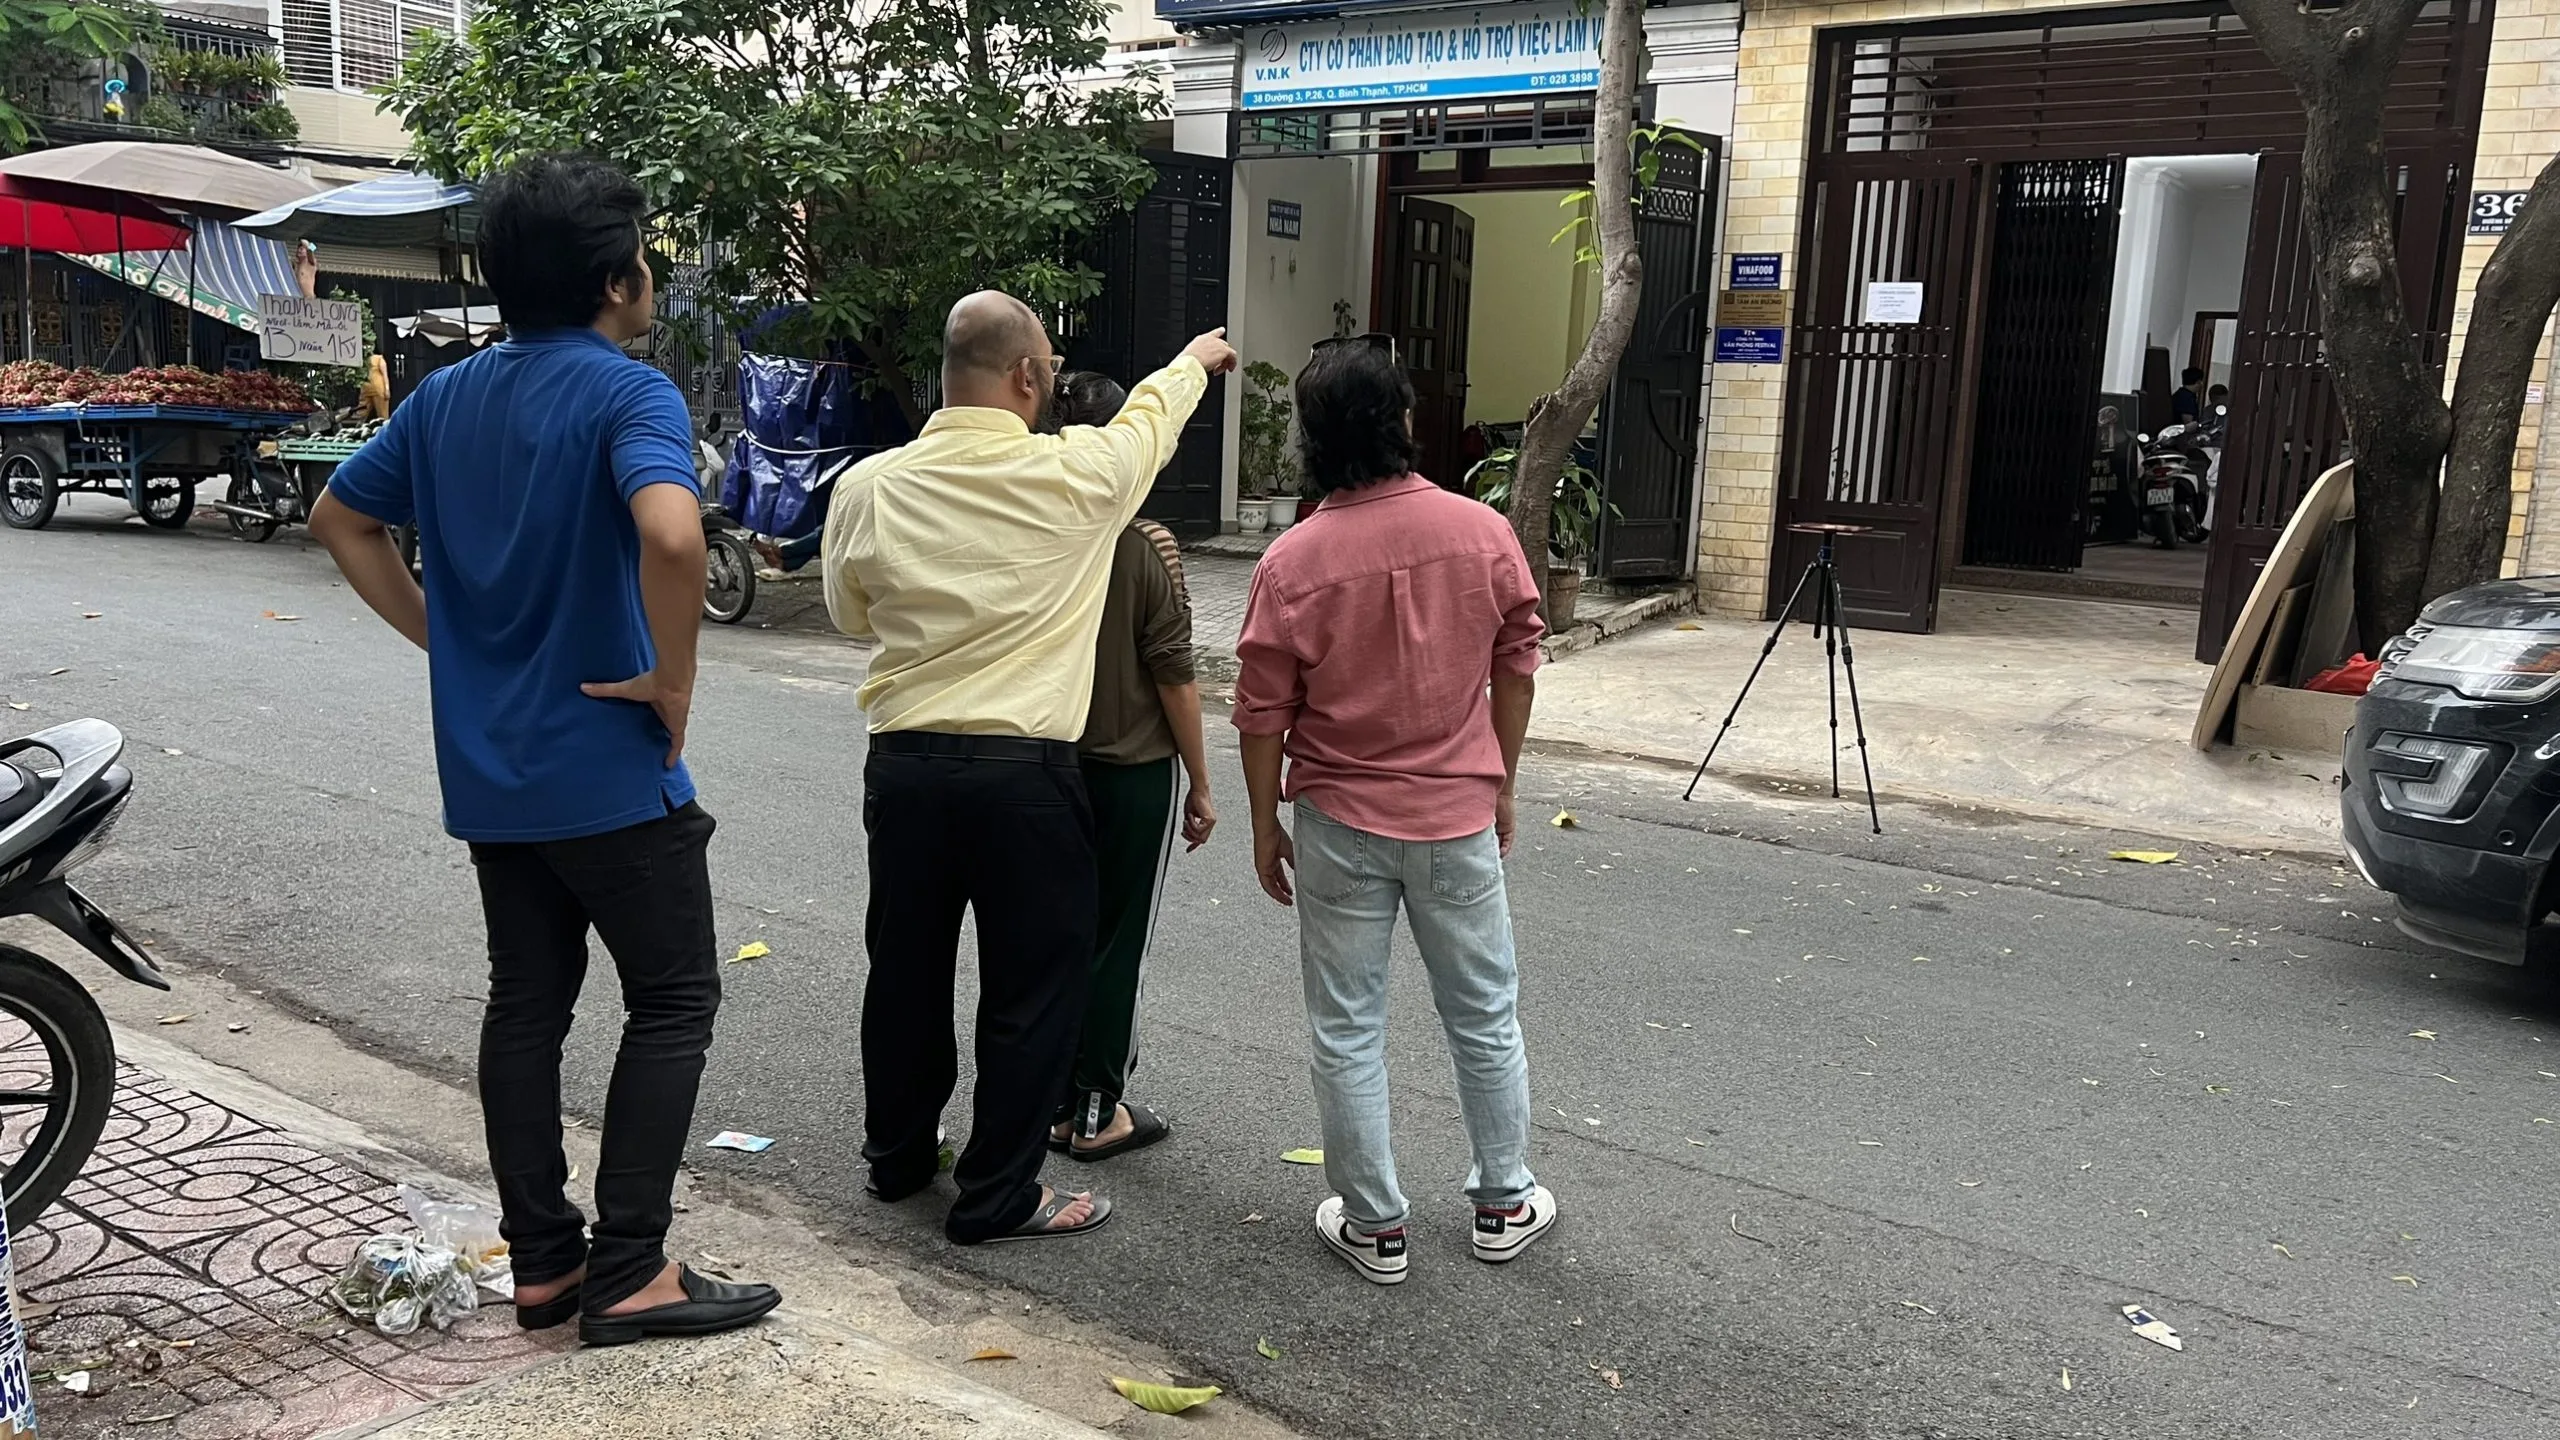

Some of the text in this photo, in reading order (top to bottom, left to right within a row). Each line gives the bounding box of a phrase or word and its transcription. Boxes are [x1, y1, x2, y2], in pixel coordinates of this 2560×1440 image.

[1300, 40, 1323, 72] CTY
[1327, 22, 1345, 70] CỔ
[1349, 22, 1383, 69] PHẦN
[1386, 25, 1413, 66] ĐÀO
[1417, 30, 1443, 70] TẠO
[1448, 28, 1458, 62] &
[1462, 11, 1481, 60] HỖ
[1486, 19, 1515, 64] TRỢ
[1519, 13, 1551, 62] VIỆC
[1555, 10, 1587, 54] LÀM
[1255, 66, 1290, 81] V.N.K
[1549, 74, 1567, 85] 028
[1264, 92, 1294, 103] Đường
[2476, 193, 2527, 216] 36
[1738, 265, 1774, 275] VINAFOOD
[1480, 1216, 1497, 1227] NIKE
[1385, 1239, 1403, 1249] NIKE
